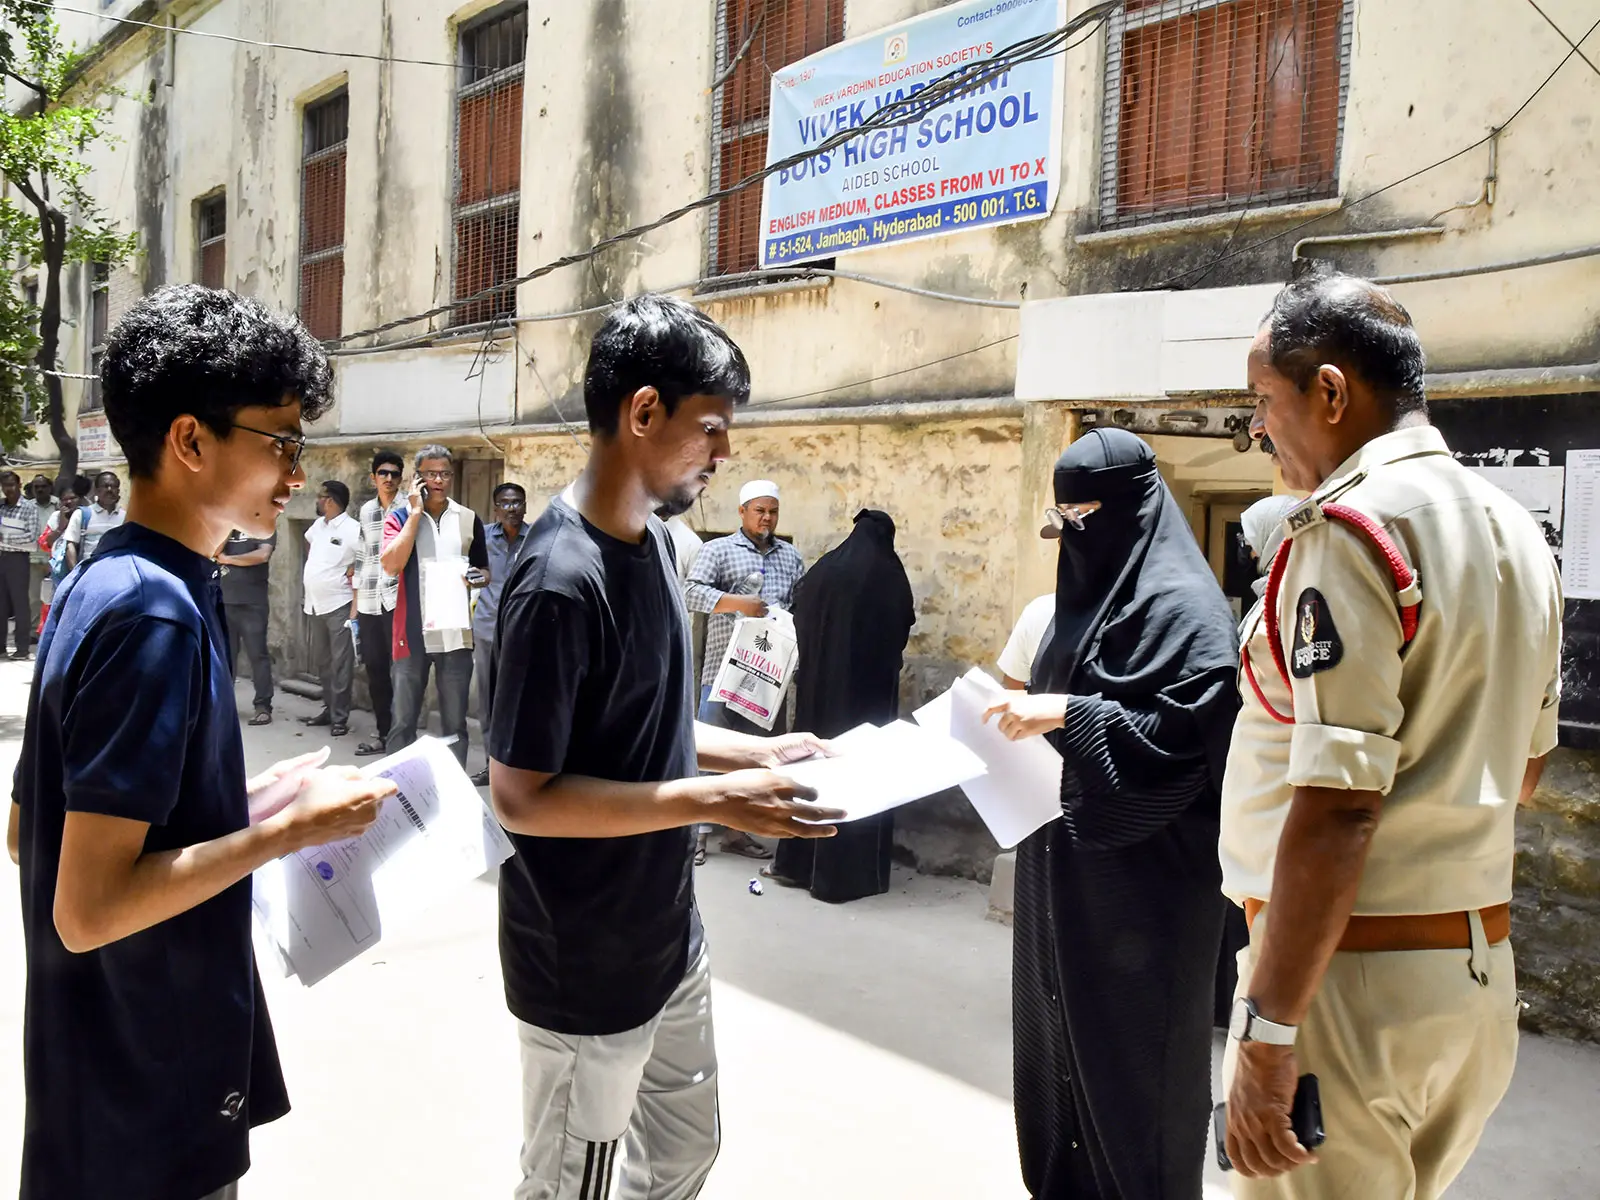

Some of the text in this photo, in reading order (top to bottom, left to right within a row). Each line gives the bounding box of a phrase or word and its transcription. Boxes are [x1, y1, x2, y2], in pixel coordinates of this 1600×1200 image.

[813, 41, 994, 109] VIVEK VARDHINI EDUCATION SOCIETY'S
[798, 100, 867, 145] VIVEK
[843, 123, 909, 168] HIGH
[916, 91, 1039, 149] SCHOOL
[769, 157, 1046, 234] ENGLISH MEDIUM, CLASSES FROM VI TO X
[842, 156, 940, 192] AIDED SCHOOL
[768, 242, 777, 260] #
[779, 235, 814, 258] 5-1-524,
[816, 224, 870, 250] Jambagh,
[872, 209, 942, 244] Hyderabad
[953, 201, 977, 224] 500
[981, 195, 1009, 218] 001.
[1013, 188, 1040, 212] T.G.
[1295, 648, 1331, 669] POCE
[1315, 641, 1332, 649] CITY
